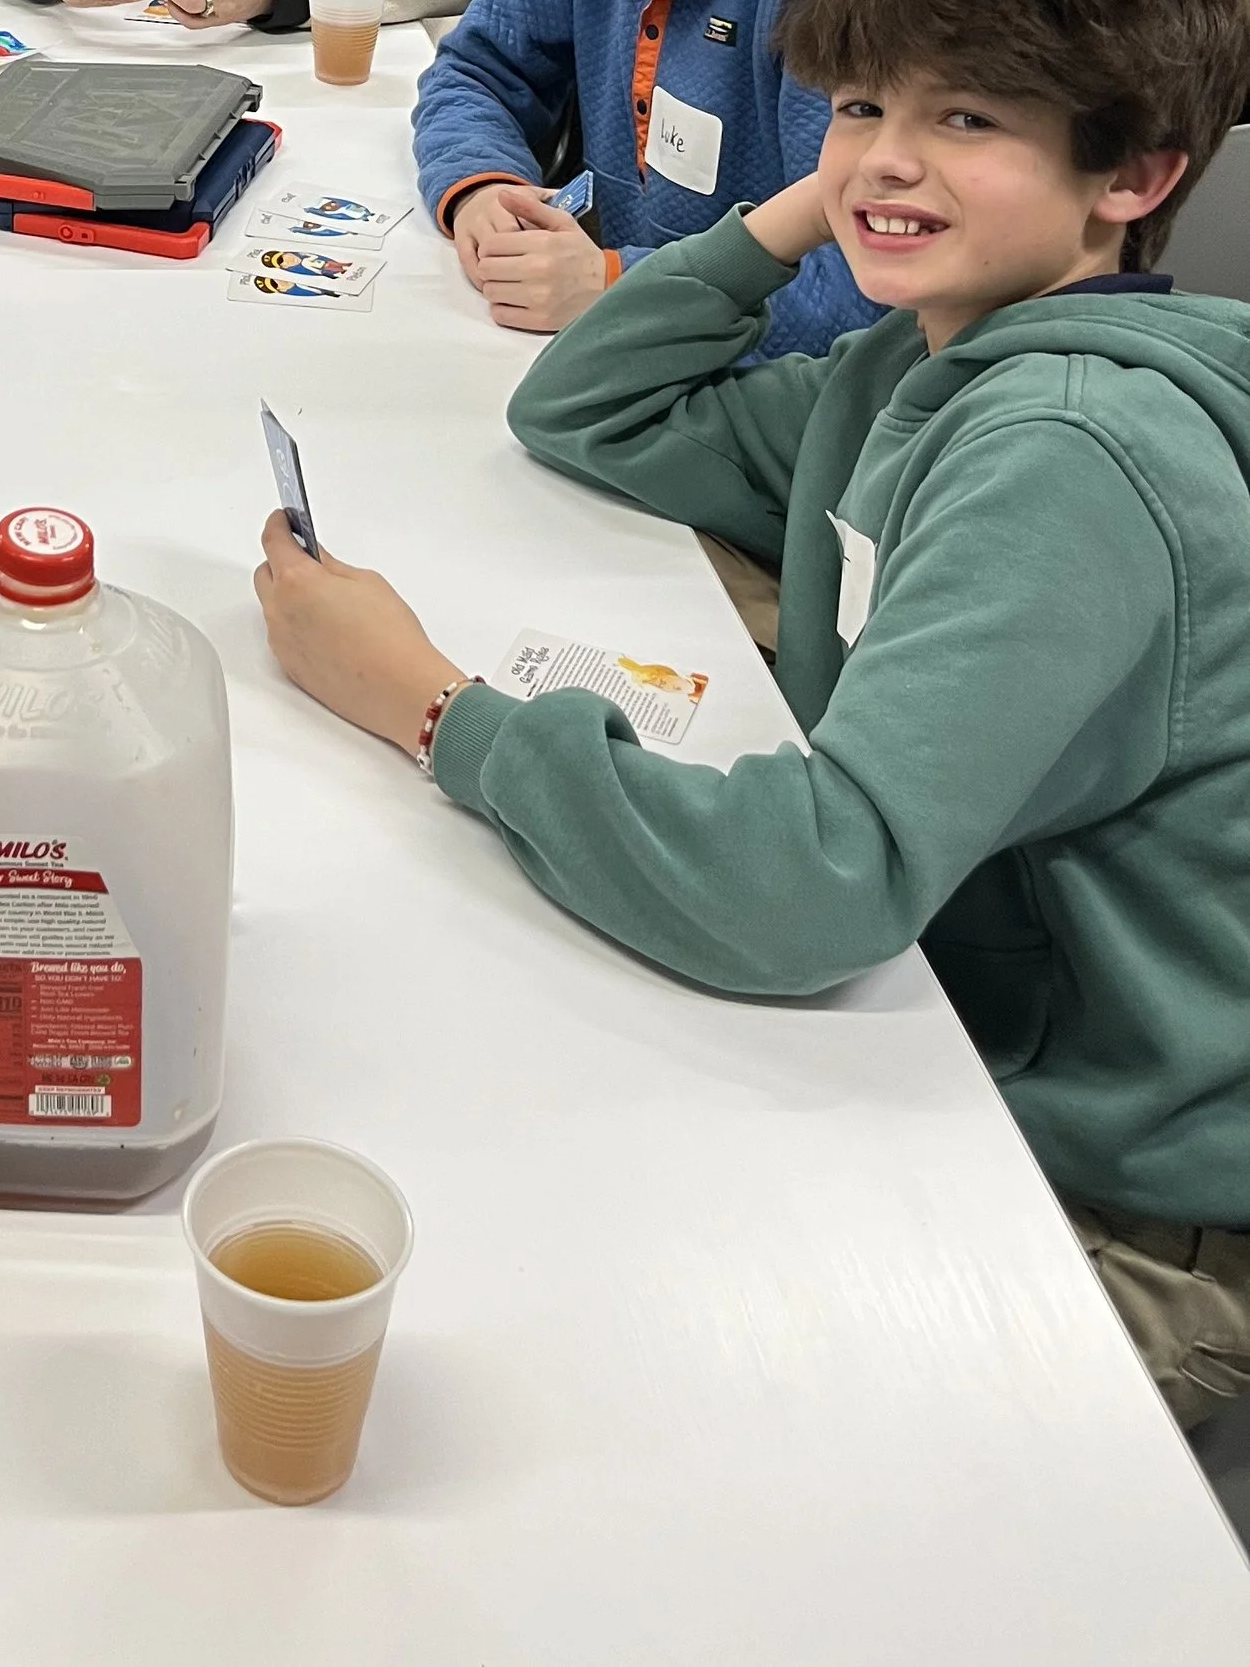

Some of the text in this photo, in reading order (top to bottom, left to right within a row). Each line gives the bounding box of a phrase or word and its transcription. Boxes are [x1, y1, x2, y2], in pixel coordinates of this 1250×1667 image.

[659, 118, 686, 153] Luke
[8, 870, 40, 884] Sweet
[43, 871, 73, 888] Story
[30, 962, 68, 973] Brewed
[70, 962, 88, 973] like
[91, 963, 108, 976] you
